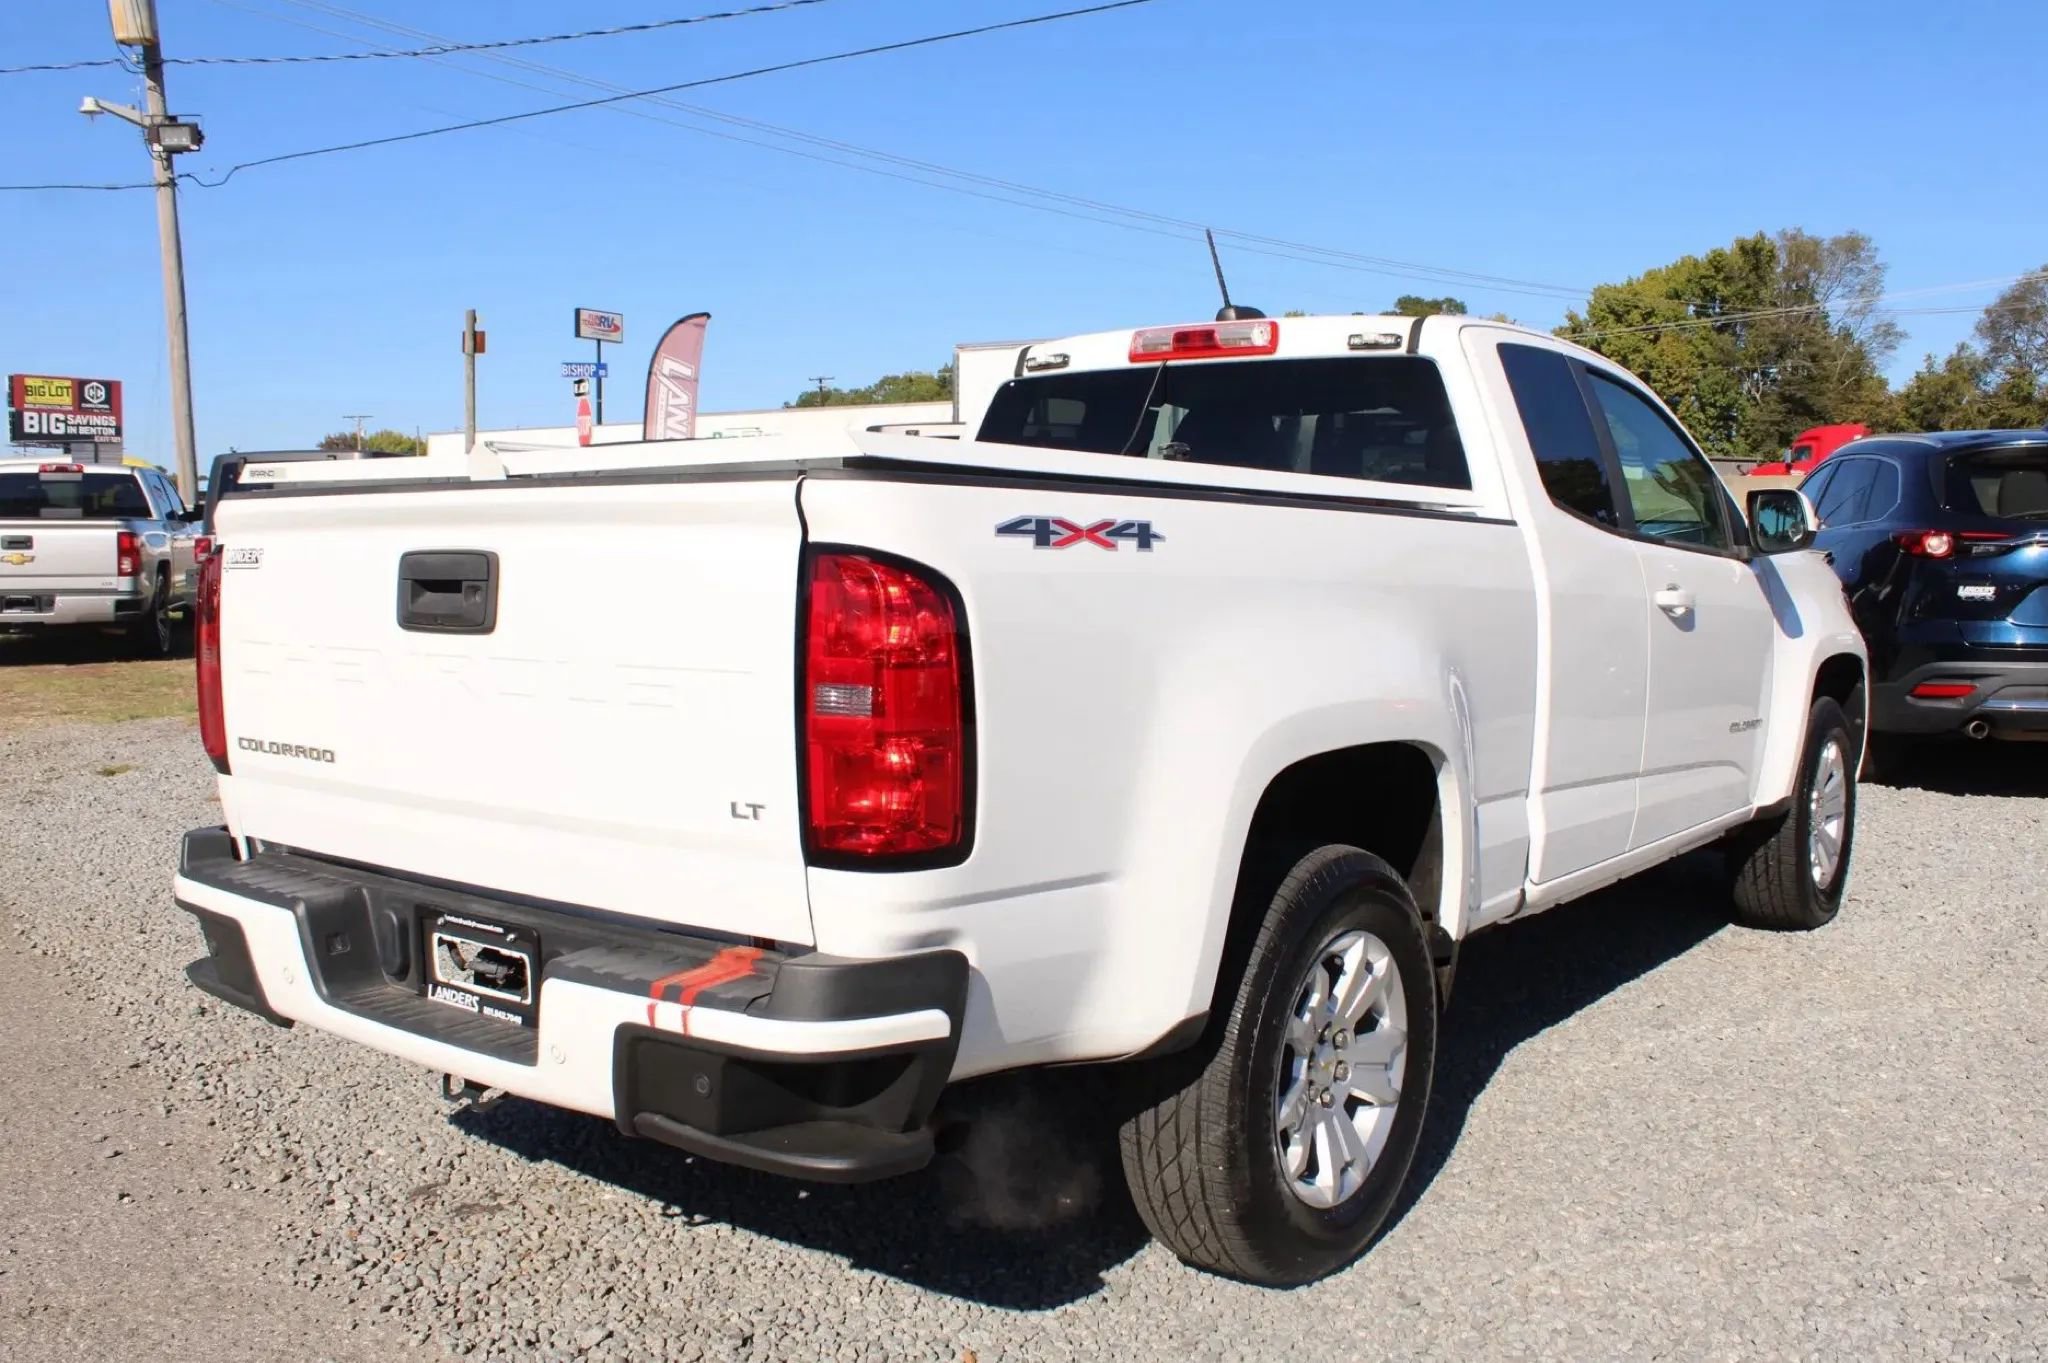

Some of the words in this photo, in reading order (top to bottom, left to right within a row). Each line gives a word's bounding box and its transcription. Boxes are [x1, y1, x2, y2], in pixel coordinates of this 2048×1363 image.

[561, 363, 597, 377] BISHOP
[25, 384, 46, 397] BIG
[48, 385, 72, 397] LOT
[23, 411, 66, 435] BIG
[66, 414, 116, 426] SAVINGS
[67, 426, 78, 435] IN
[78, 426, 116, 436] BENTON
[238, 736, 336, 763] COLORADO
[730, 801, 766, 821] LT
[427, 984, 480, 1013] LANDERS
